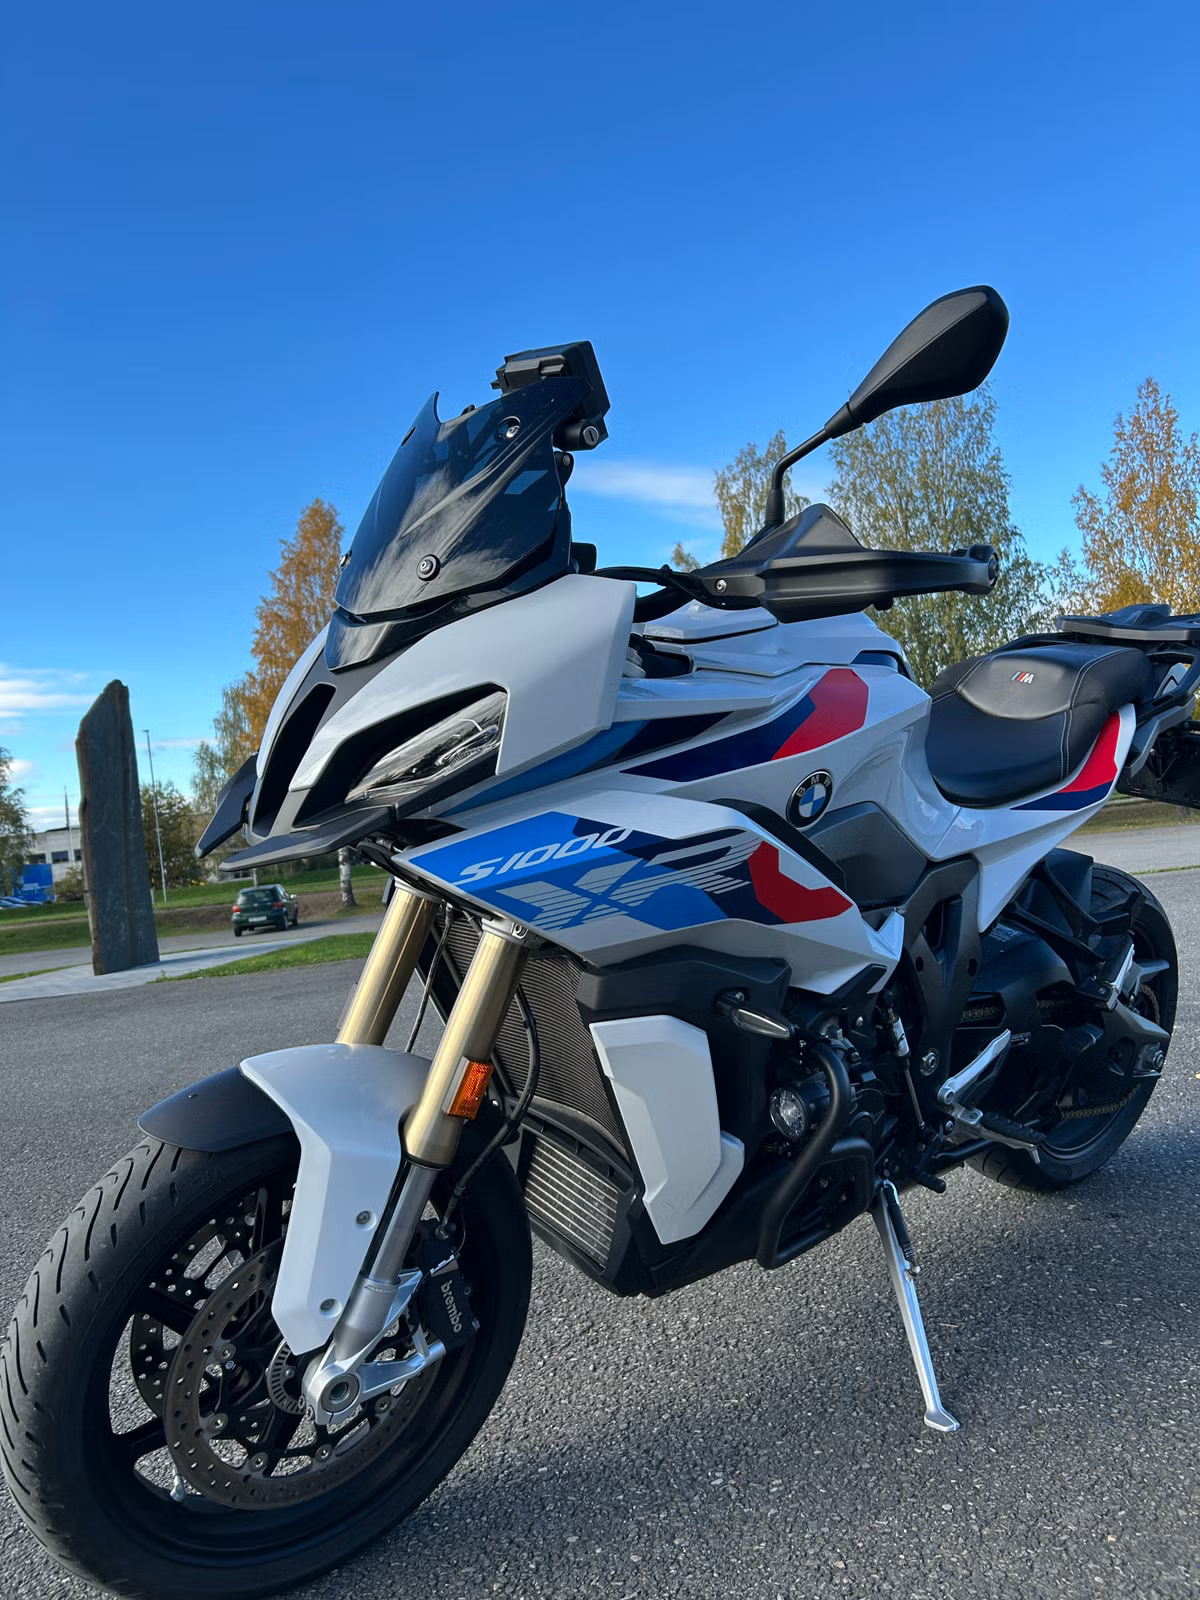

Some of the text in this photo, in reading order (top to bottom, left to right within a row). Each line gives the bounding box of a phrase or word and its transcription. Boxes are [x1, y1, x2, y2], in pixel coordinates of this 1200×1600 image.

[795, 774, 832, 798] BMW
[450, 826, 635, 886] S1000
[440, 1279, 463, 1333] brembo
